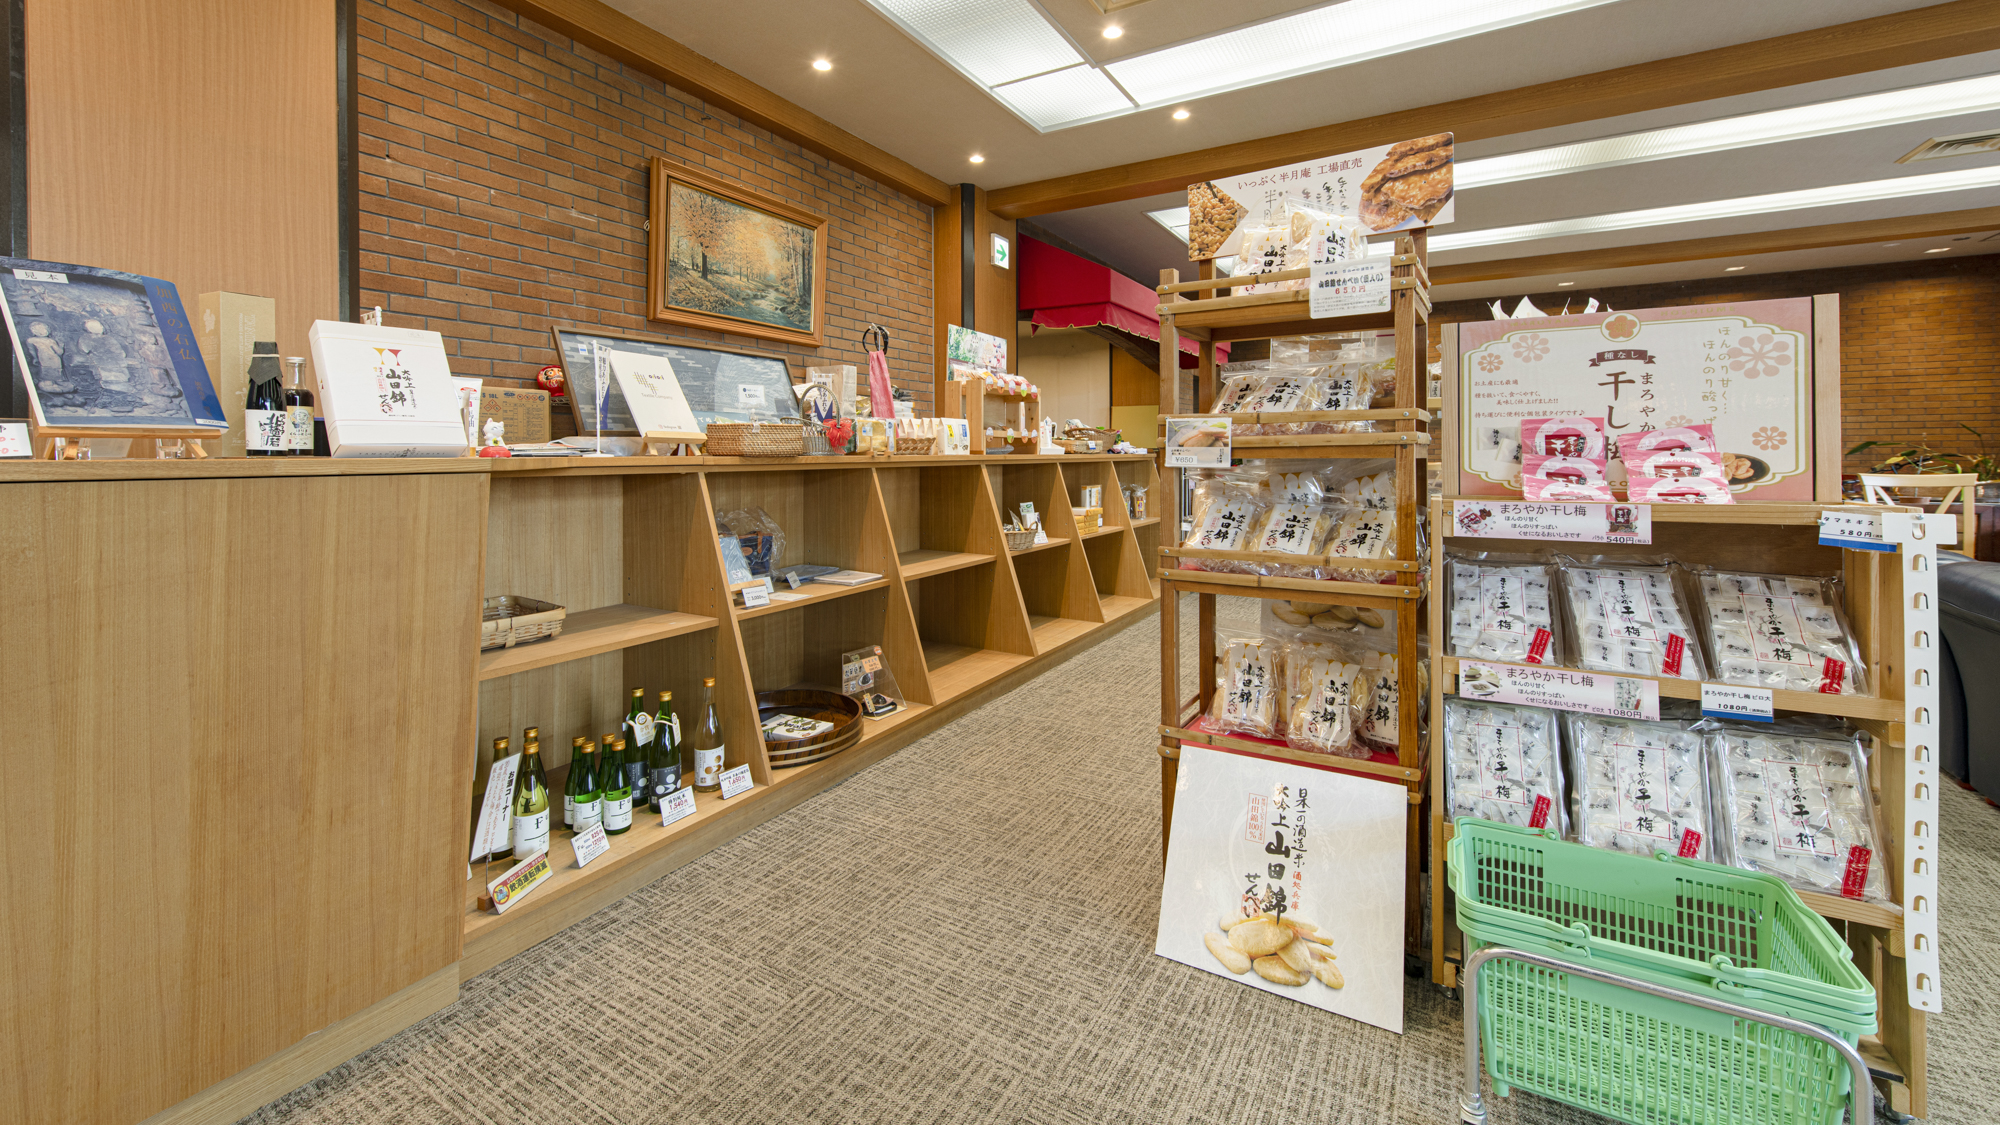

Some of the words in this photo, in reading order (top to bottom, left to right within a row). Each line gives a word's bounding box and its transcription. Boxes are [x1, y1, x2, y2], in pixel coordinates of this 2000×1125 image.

[1317, 157, 1363, 175] 工場直売
[25, 271, 59, 281] 見本
[1335, 285, 1366, 295] 650円
[1660, 306, 1735, 317] HOSHIUME
[155, 285, 197, 361] 加西の石仏
[1604, 351, 1639, 360] 種なし
[385, 368, 407, 407] 山田錦
[401, 369, 416, 389] 大吟上
[1640, 372, 1656, 432] まろやか
[1500, 504, 1587, 517] まろやか干し梅
[1214, 511, 1235, 543] 山田錦
[1279, 515, 1300, 543] 山田錦
[1823, 516, 1882, 526] タマネギス
[1518, 530, 1582, 539] くせになるおいしさです
[1606, 536, 1634, 544] 540円
[1840, 529, 1872, 538] 580円
[1238, 663, 1255, 708] 山田錦
[1506, 667, 1594, 687] まろやか干し梅
[1511, 680, 1546, 689] ほんのり甘く
[1338, 681, 1349, 706] 大吟上
[1374, 676, 1392, 727] 山田錦
[1518, 689, 1565, 698] ほんのりすっぱい
[1525, 697, 1589, 709] くせになるおいしさです
[1704, 690, 1751, 700] まろやか干し梅
[1320, 680, 1339, 728] 山田錦
[1608, 708, 1642, 719] 1080円
[1718, 703, 1748, 712] 1080円
[503, 771, 515, 821] お酒コーナー
[1271, 783, 1291, 829] 大吟上
[1290, 788, 1311, 868] 日本一の酒造米
[509, 860, 548, 893] 飲酒運転撲滅
[1260, 830, 1291, 926] 山田錦
[1244, 872, 1261, 918] せんべい
[1291, 871, 1302, 911] 酒処兵庫
